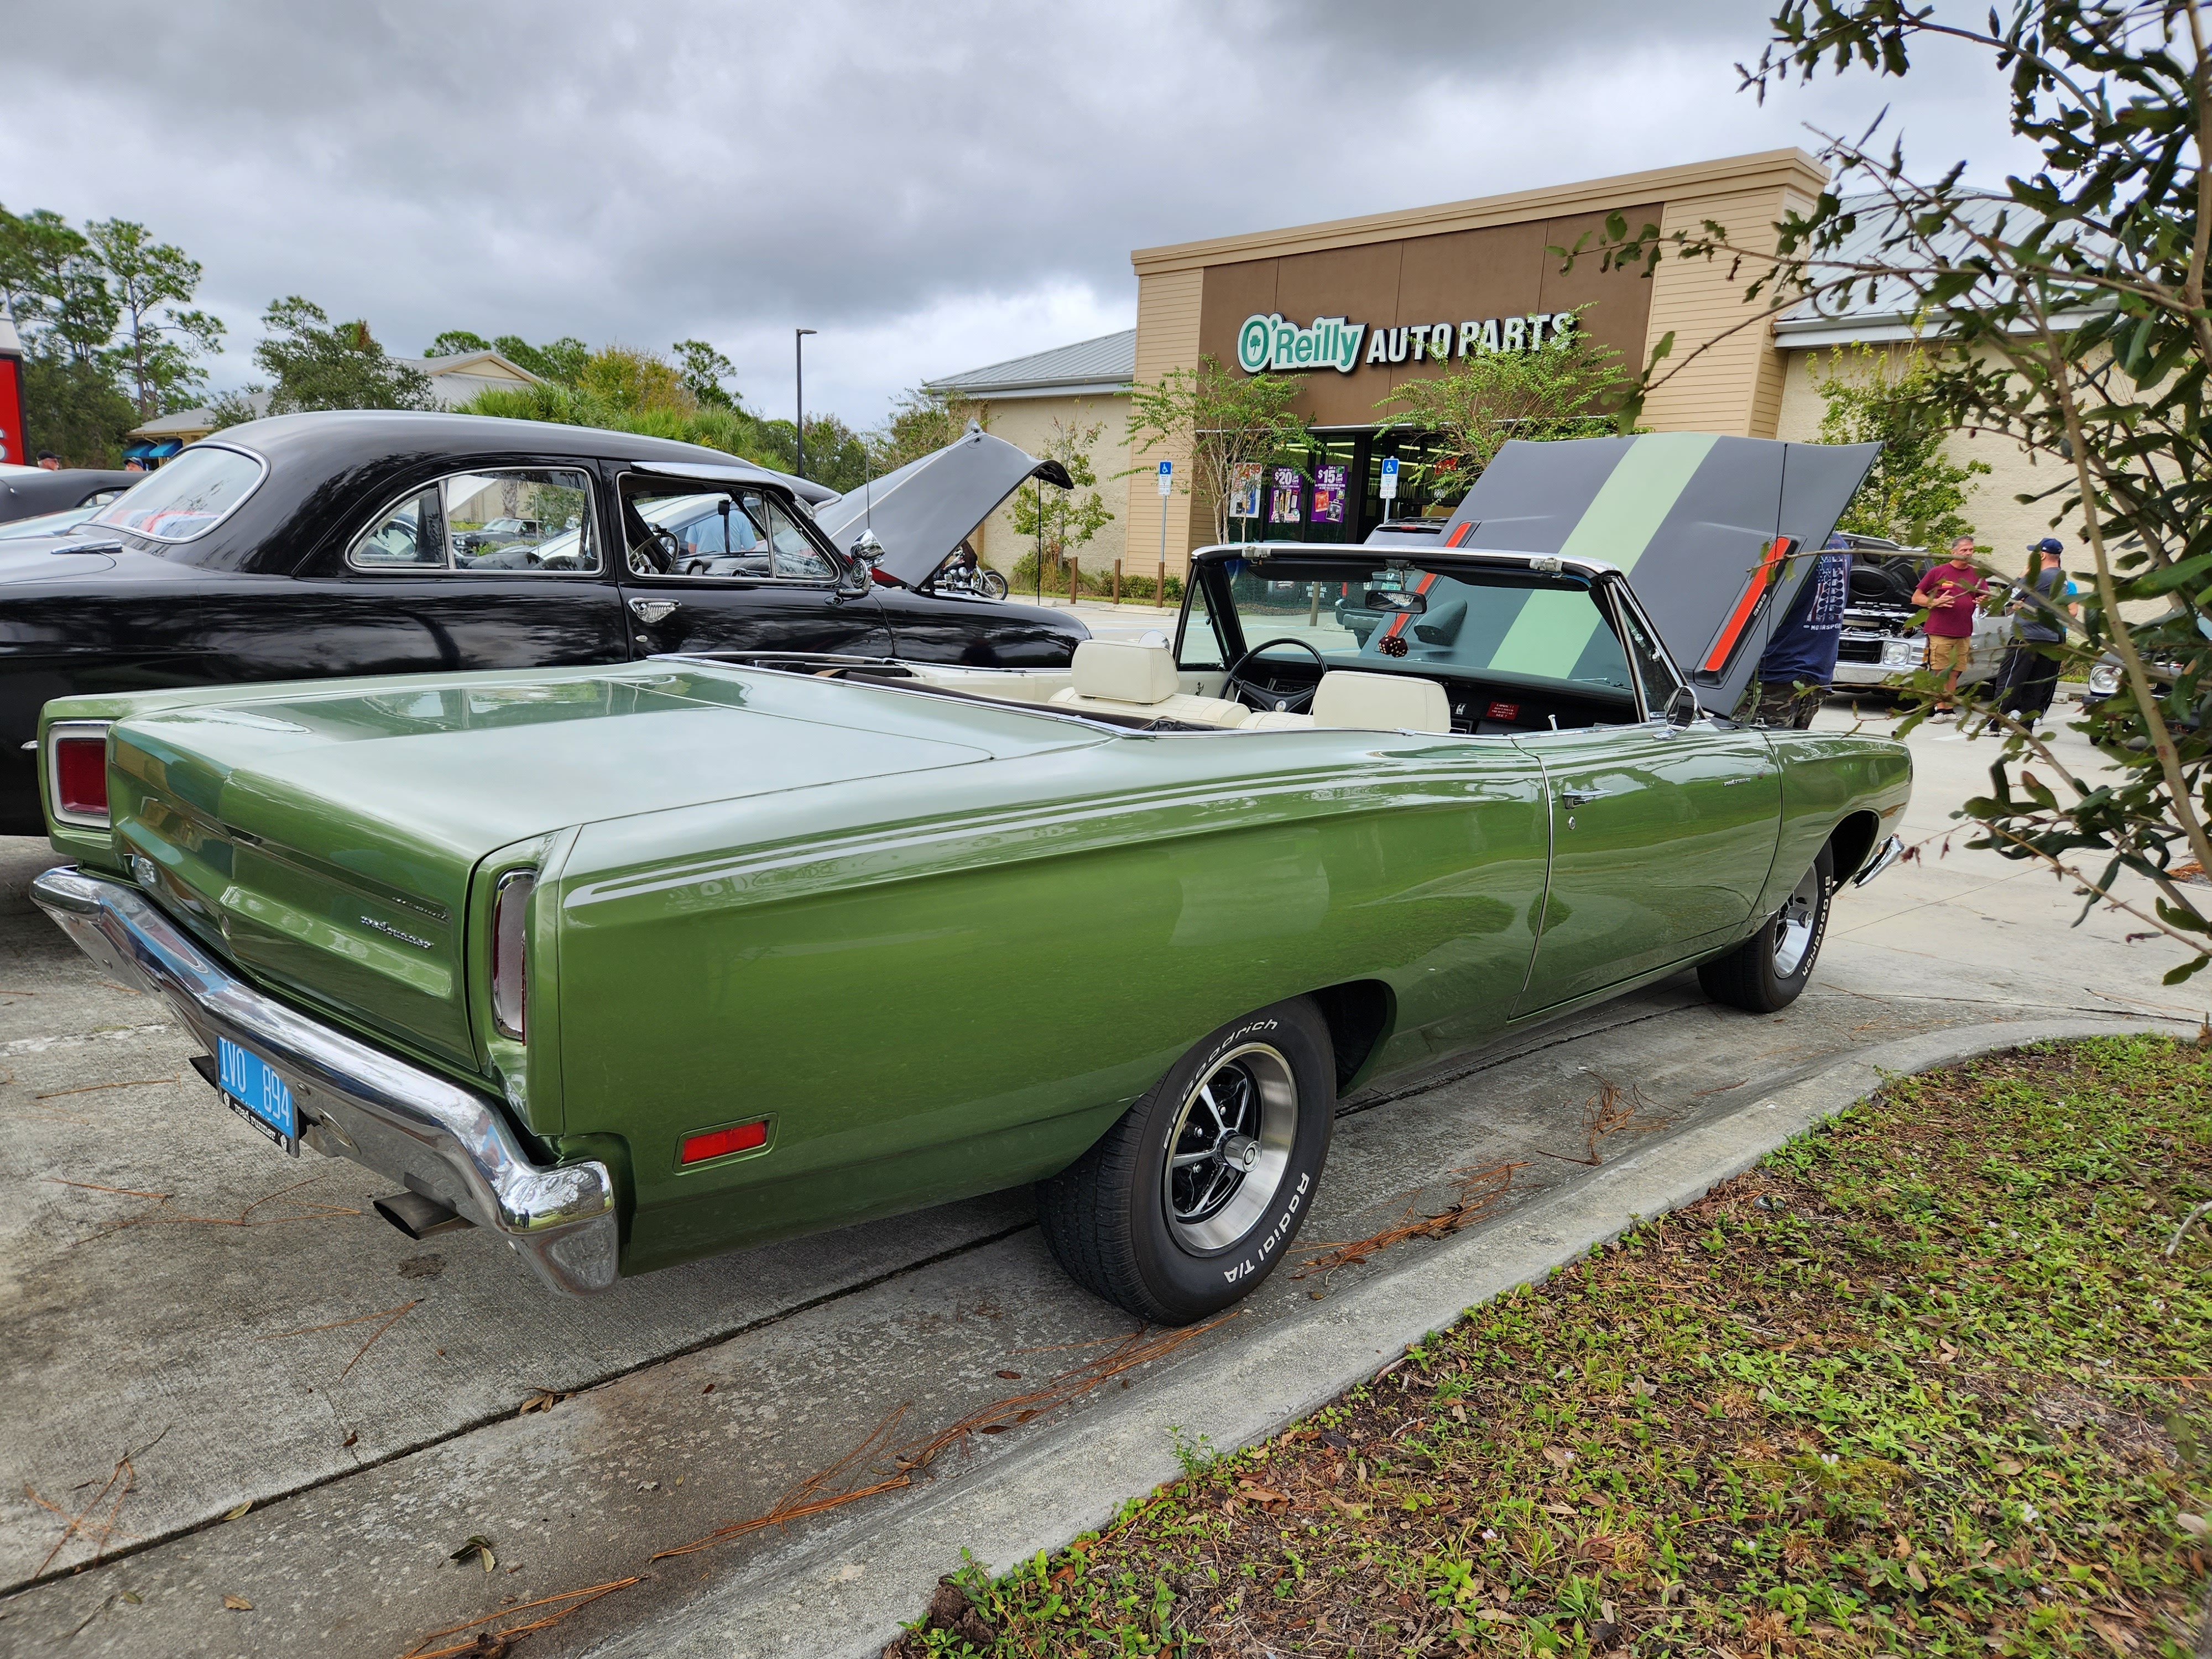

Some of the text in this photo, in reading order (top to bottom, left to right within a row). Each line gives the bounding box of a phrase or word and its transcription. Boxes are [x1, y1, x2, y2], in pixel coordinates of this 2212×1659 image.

[1241, 312, 1577, 367] O'Reilly AUTO PARTS
[1275, 471, 1292, 485] $20
[1318, 469, 1335, 483] $15
[1802, 875, 1831, 977] BFGoodrich
[219, 1037, 247, 1093] IVO
[262, 1064, 290, 1127] 894
[1162, 1018, 1279, 1150] BFGoodrich
[234, 1103, 251, 1122] road
[250, 1115, 276, 1140] runner
[1224, 1172, 1310, 1284] Radial T/A
